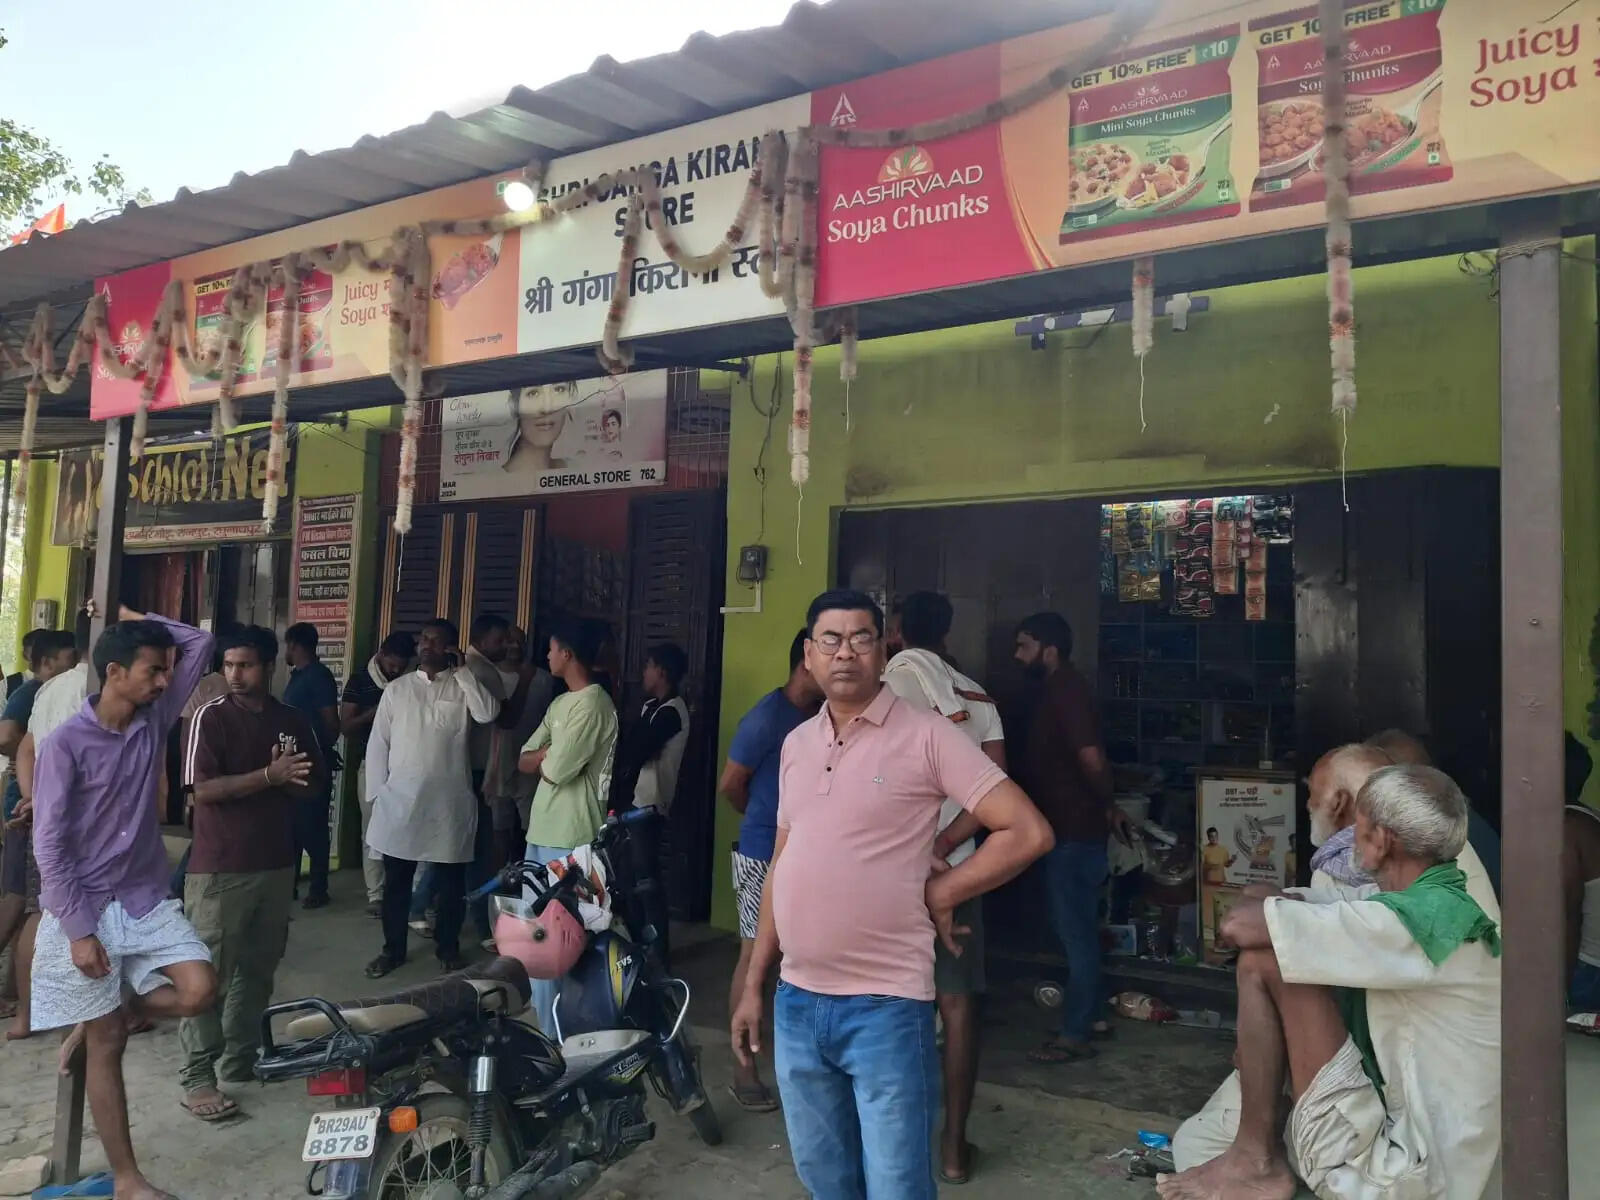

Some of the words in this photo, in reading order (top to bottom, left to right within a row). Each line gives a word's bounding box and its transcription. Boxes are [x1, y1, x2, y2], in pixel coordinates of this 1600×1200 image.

[1259, 27, 1295, 46] GET
[1302, 18, 1321, 36] 10
[1474, 23, 1580, 74] Juicy
[1071, 71, 1103, 90] GET
[1109, 63, 1143, 81] 10%
[1470, 65, 1578, 108] Soya
[1109, 88, 1189, 113] AASHIRVAAD
[1101, 120, 1124, 134] Mini
[1126, 117, 1153, 130] Soya
[1155, 106, 1197, 123] Chunks
[832, 164, 984, 212] AASHIRVAAD
[827, 215, 888, 244] Soya
[892, 193, 990, 230] Chunks
[344, 280, 379, 305] Juicy
[524, 276, 554, 315] श्री
[340, 305, 377, 327] Soya
[539, 473, 591, 488] GENERAL
[593, 469, 632, 485] STORE
[640, 468, 656, 481] 762
[616, 955, 633, 969] TVS
[317, 1116, 369, 1134] BR29AU
[308, 1134, 369, 1156] 8878
